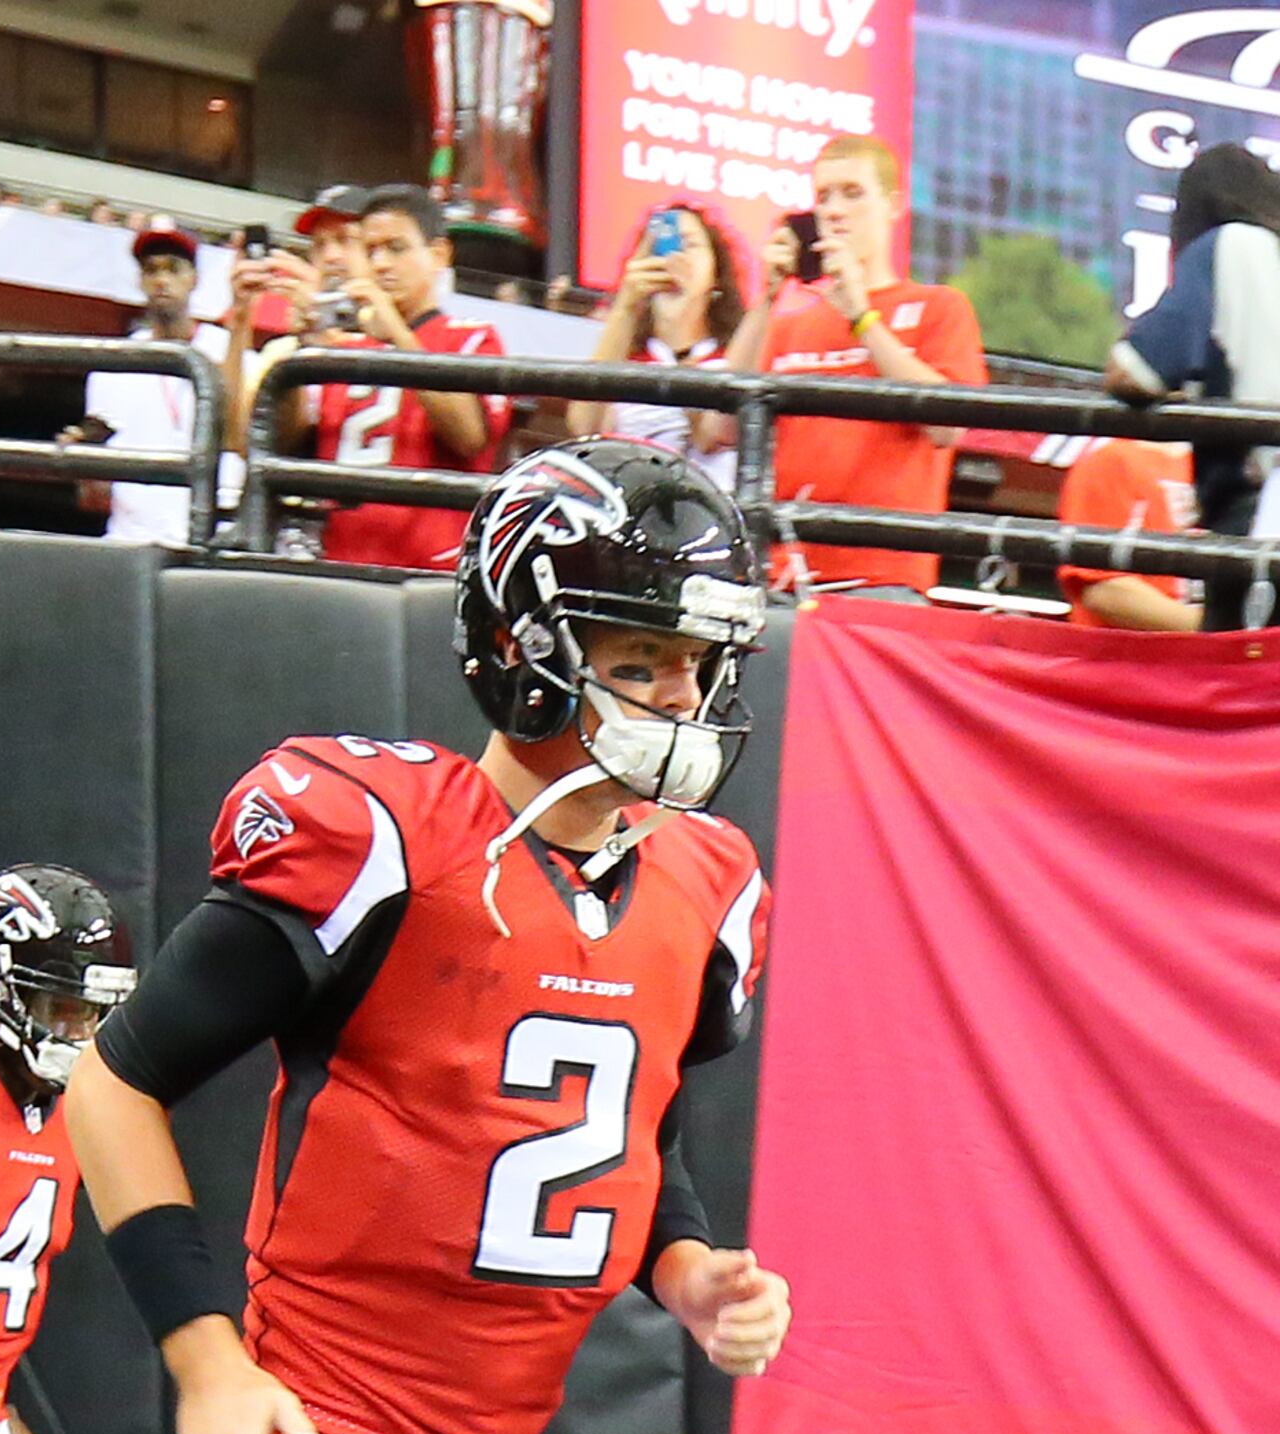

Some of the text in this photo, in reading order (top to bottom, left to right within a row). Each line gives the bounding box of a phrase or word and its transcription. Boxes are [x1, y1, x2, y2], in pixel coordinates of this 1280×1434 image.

[624, 49, 874, 135] YOUR HOME
[622, 97, 700, 143] FOR
[703, 112, 774, 158] THE
[622, 141, 716, 192] LIVE
[539, 973, 635, 997] FALCONS
[472, 1011, 637, 1285] 2
